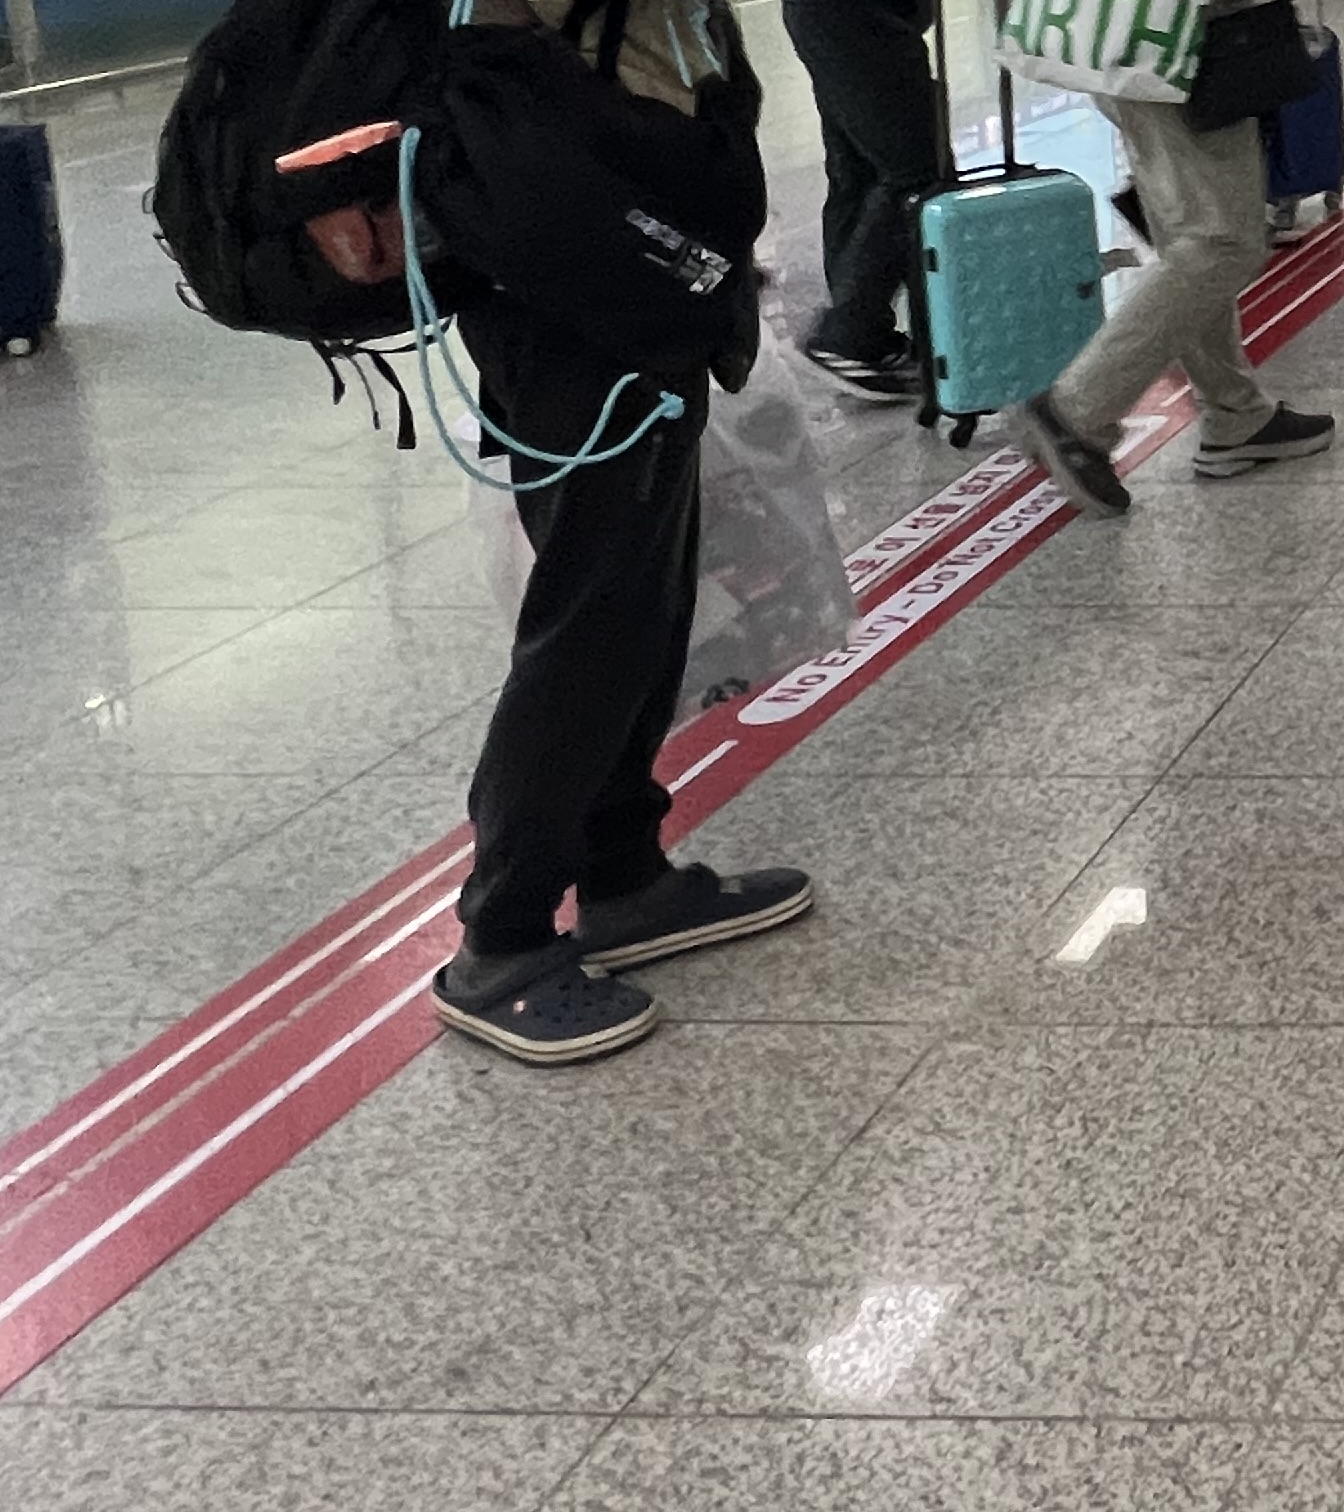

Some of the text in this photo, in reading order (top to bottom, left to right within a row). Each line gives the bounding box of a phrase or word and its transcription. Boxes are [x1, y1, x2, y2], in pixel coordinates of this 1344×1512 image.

[875, 536, 922, 551] 이
[763, 673, 828, 703] No
[811, 614, 910, 667] Entry
[906, 569, 959, 593] Do
[937, 536, 1010, 569] Not
